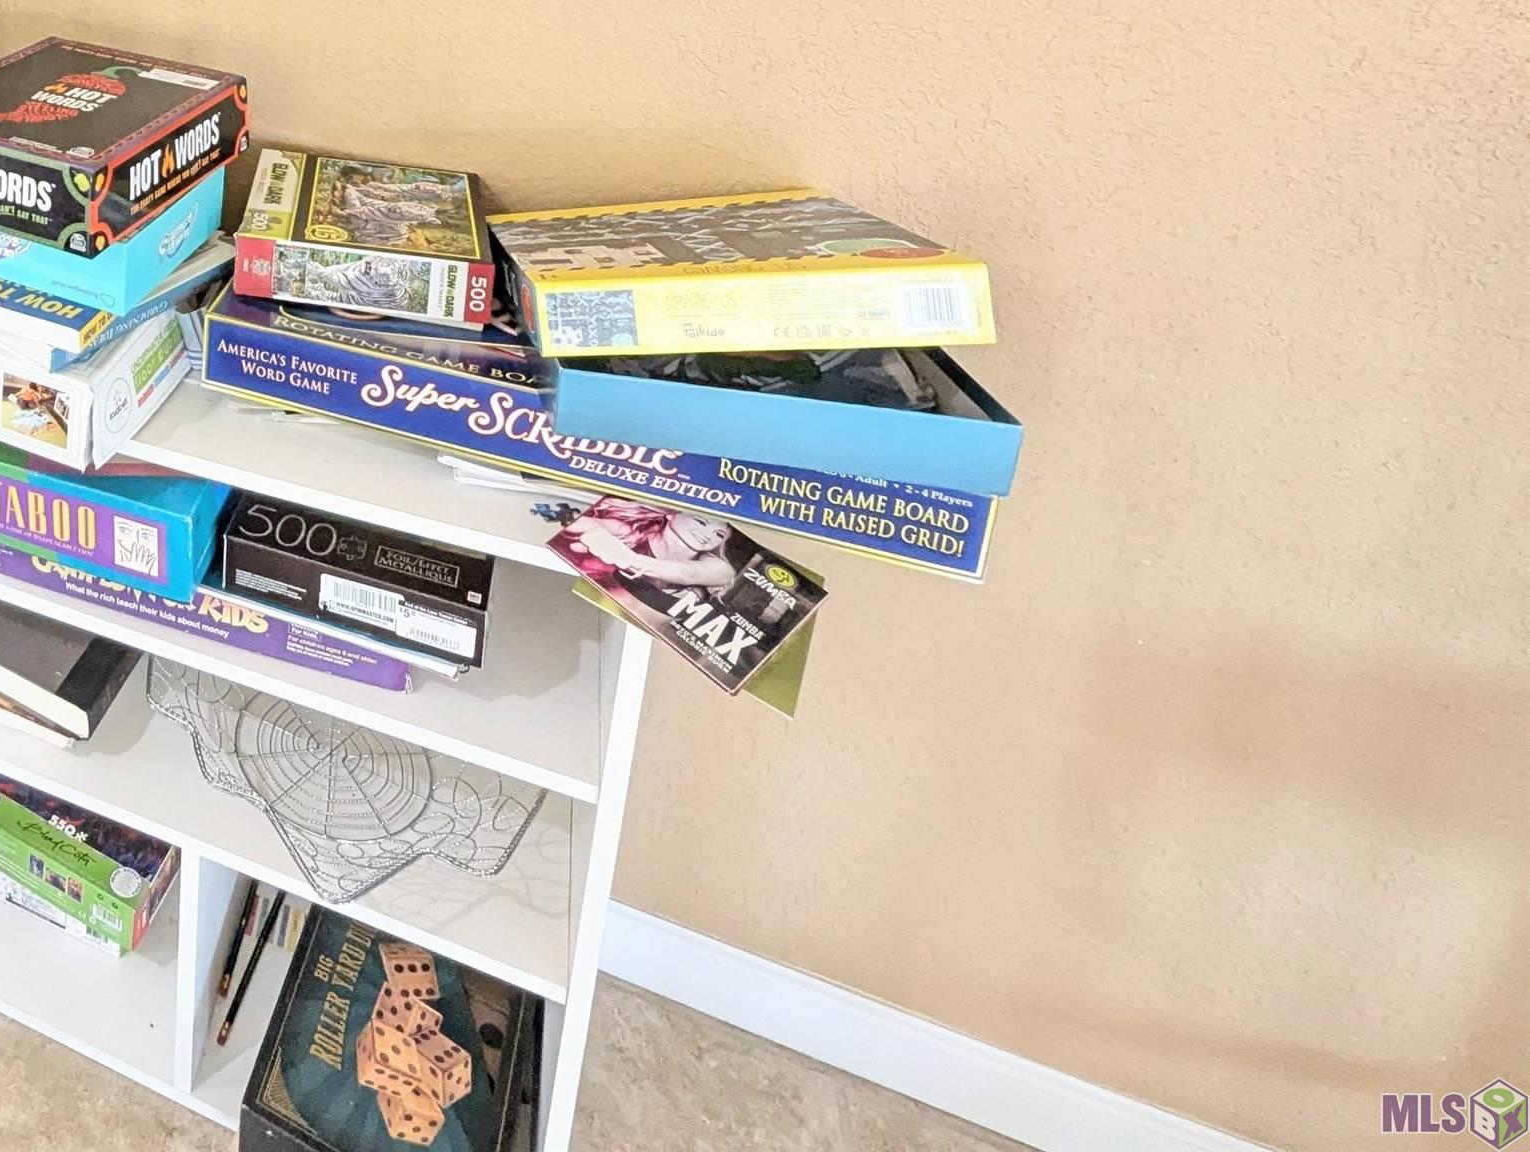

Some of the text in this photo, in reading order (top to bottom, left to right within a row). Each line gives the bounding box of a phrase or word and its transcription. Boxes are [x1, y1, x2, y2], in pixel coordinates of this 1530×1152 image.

[31, 91, 99, 113] WORDS
[65, 88, 117, 103] HOT
[129, 114, 220, 201] HOT WORDS
[17, 209, 30, 222] SAY
[32, 213, 50, 225] THAT
[253, 212, 269, 231] 500
[13, 288, 82, 321] HOW
[443, 265, 458, 318] GLOW DARK
[469, 276, 488, 312] 500
[217, 339, 358, 385] AMERICA'S FAVORITE
[273, 315, 479, 374] ROTATING GAME
[241, 360, 330, 395] WORD GAME
[362, 365, 479, 413] Super
[570, 454, 741, 508] DELUXE EDITION
[719, 458, 969, 534] ROTATING GAME BOARD
[855, 473, 973, 508] Adult Players
[238, 504, 337, 556] 500
[760, 495, 965, 557] WITH RAISED GRID!
[65, 581, 230, 639] What the rich teach their kids about money
[743, 568, 797, 610] ZUMBA
[198, 596, 269, 635] KIDS
[667, 589, 758, 666] MAX
[730, 612, 764, 640] ZUMBA
[288, 635, 299, 643] For
[300, 637, 325, 649] children
[326, 645, 341, 654] ages
[348, 649, 360, 659] and
[314, 953, 334, 982] BIG
[309, 942, 368, 1071] ROLLER YARD
